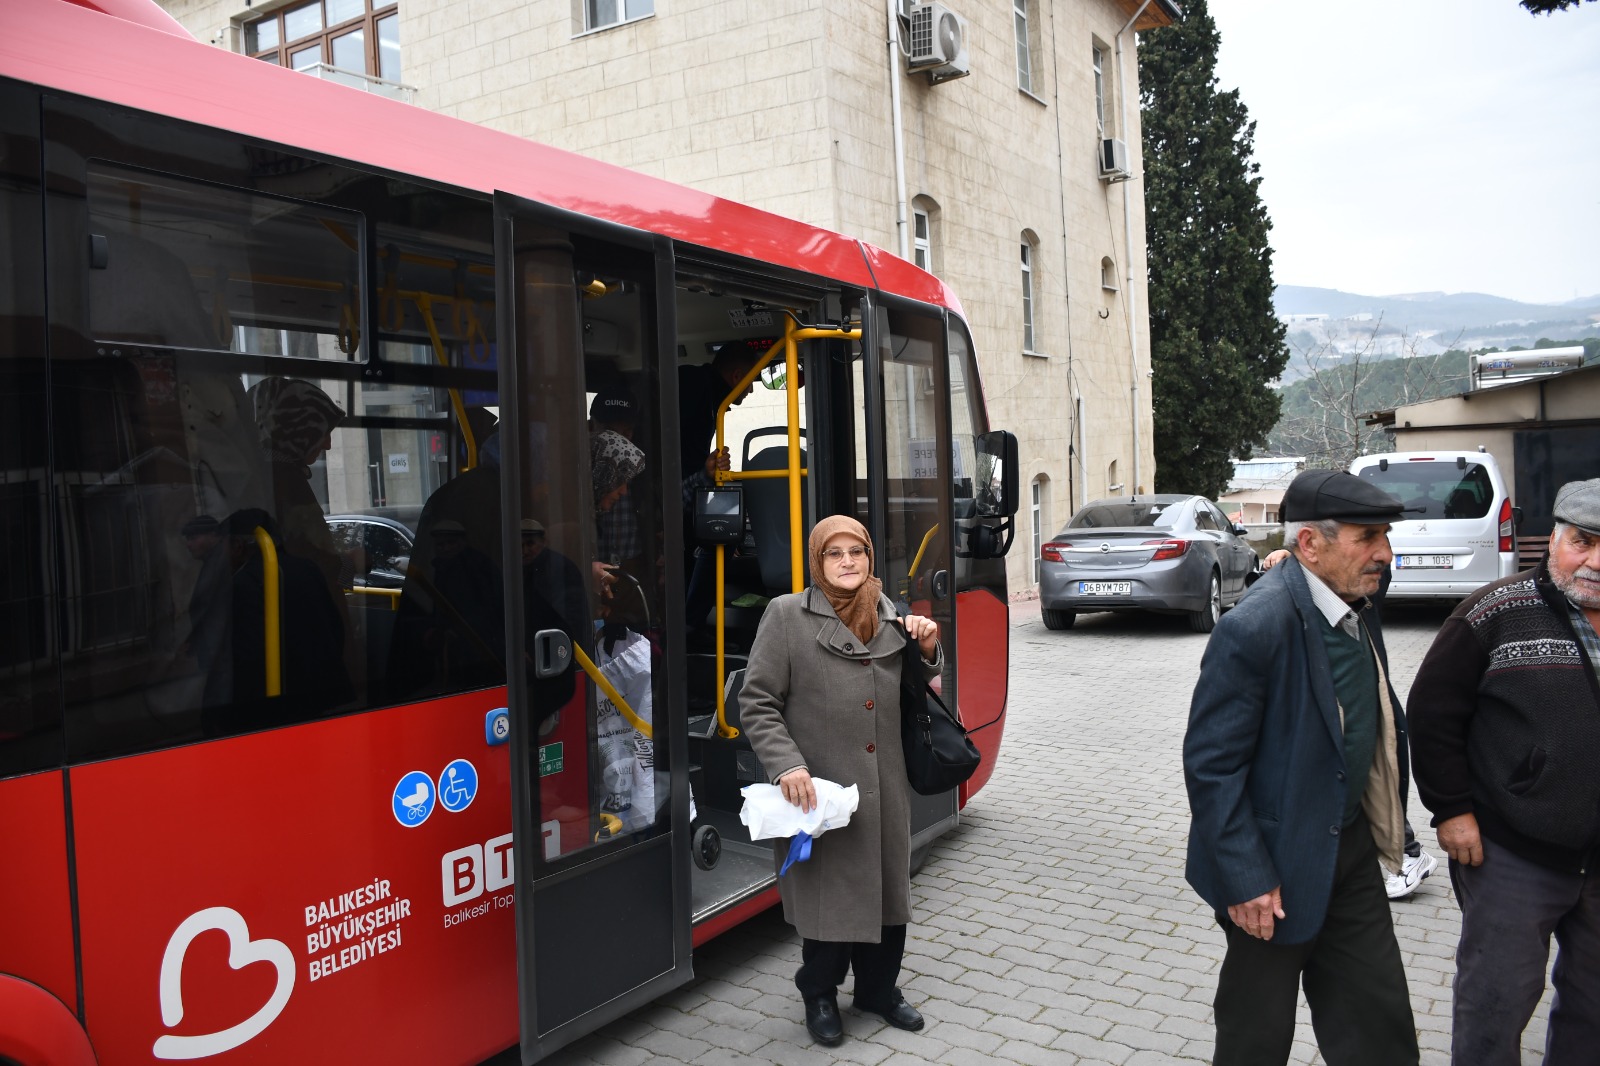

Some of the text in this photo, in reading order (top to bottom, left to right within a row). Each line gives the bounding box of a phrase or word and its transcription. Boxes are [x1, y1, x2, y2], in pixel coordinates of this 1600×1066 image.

[604, 399, 629, 408] QUICK
[391, 457, 407, 468] GİRİŞ
[1402, 556, 1411, 565] 10
[1432, 555, 1451, 565] 1035
[305, 877, 391, 926] BALIKESİR
[443, 901, 490, 929] Balıkesir
[307, 896, 411, 955] BÜYÜKŞEHİR
[309, 923, 402, 982] BELEDİYESİ
